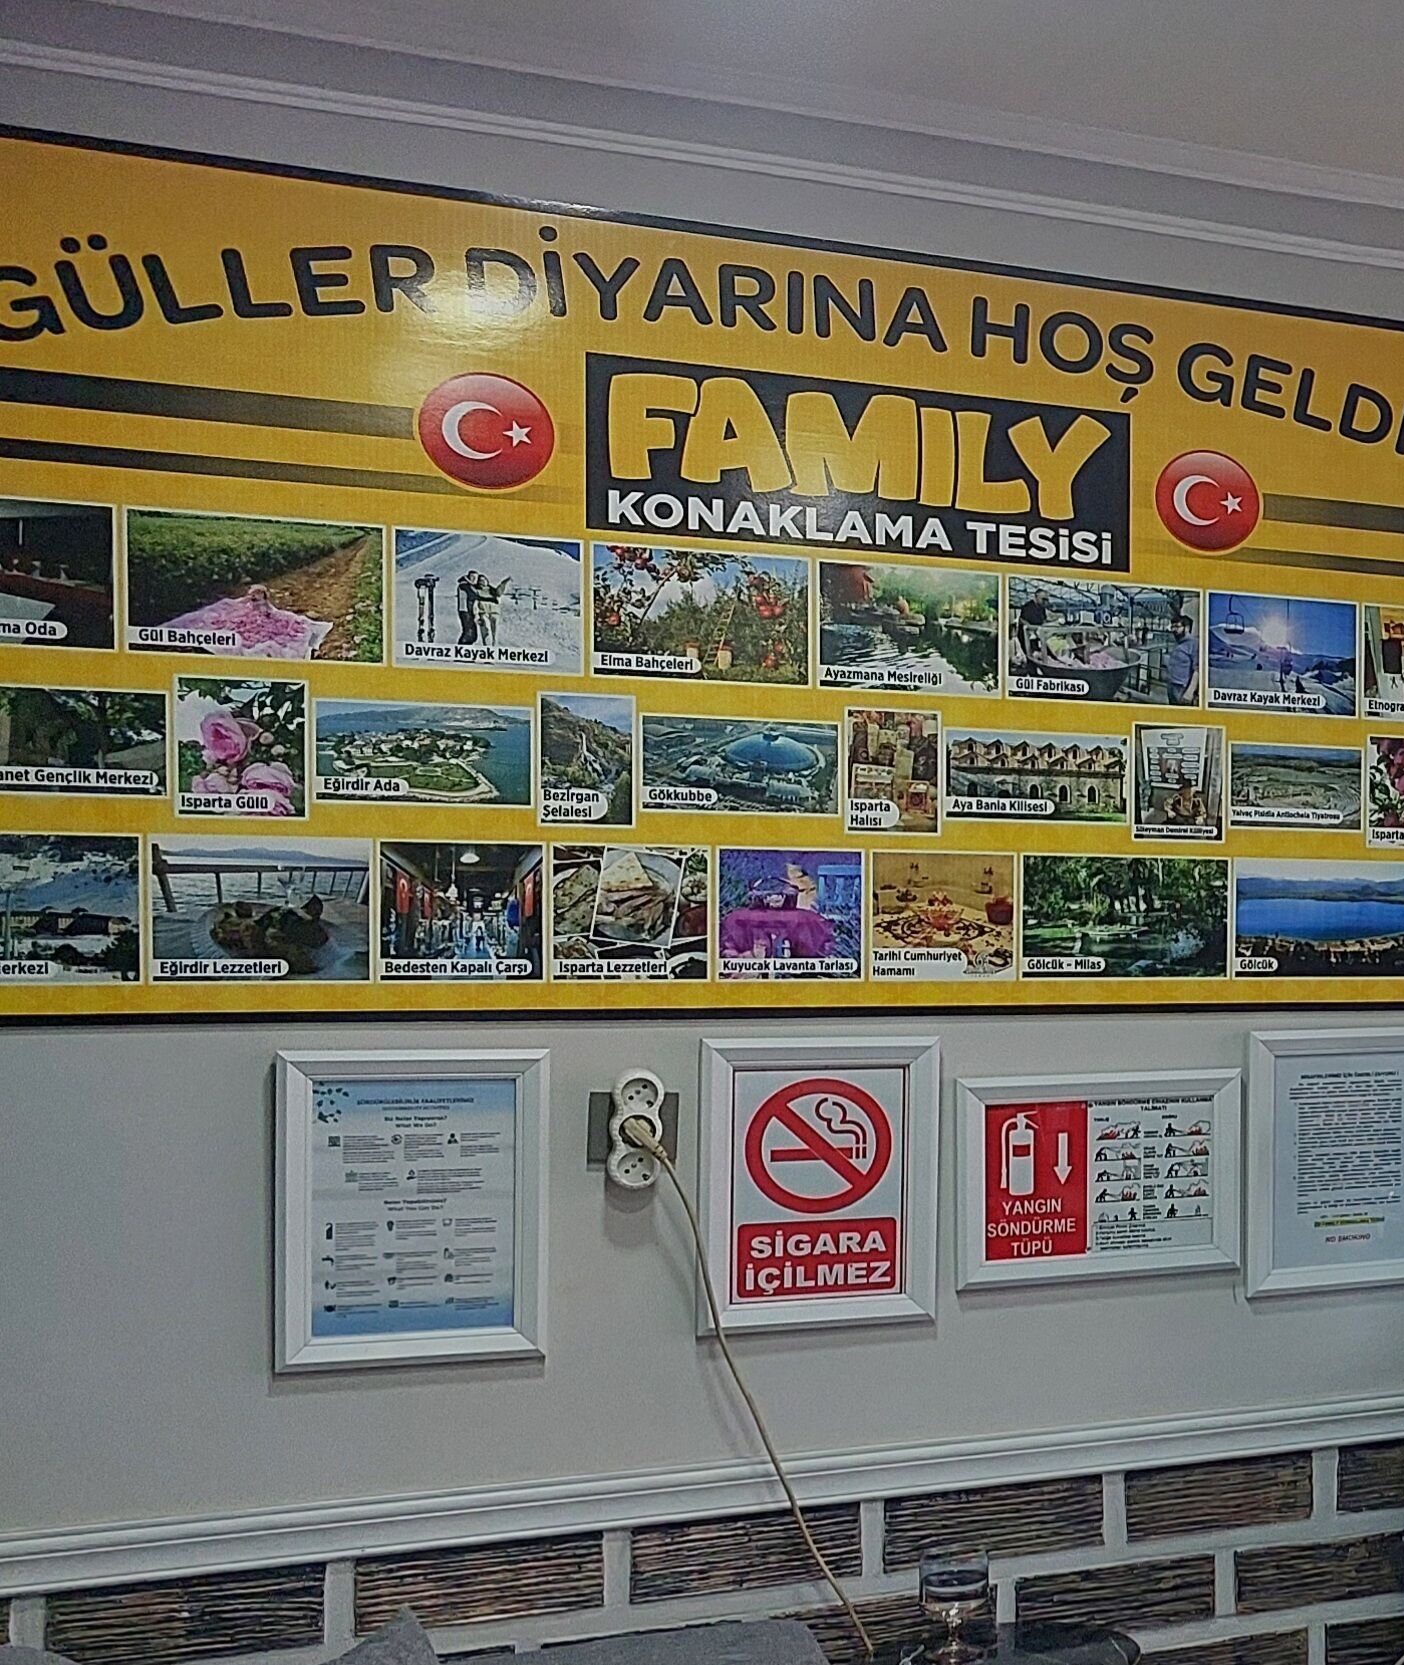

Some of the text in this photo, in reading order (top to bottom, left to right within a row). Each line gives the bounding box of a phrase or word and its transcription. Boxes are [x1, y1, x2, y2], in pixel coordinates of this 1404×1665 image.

[0, 234, 436, 342] GÜLLER
[464, 225, 947, 354] DİYARINA
[970, 296, 1156, 404] HOŞ
[606, 371, 1112, 521] FAMILY
[606, 490, 1113, 566] KONAKLAMA TESİSİ
[25, 621, 57, 636] Oda
[138, 628, 236, 648] Gül Bahçeleri
[405, 643, 549, 664] Davraz Kayak Merkezi
[600, 654, 694, 672] Elma Bahçeleri
[824, 666, 943, 686] Ayazmana Mesireliği
[1015, 677, 1086, 693] Gül Fabrikası
[1213, 691, 1321, 707] Davraz Kayak Merkezi
[35, 769, 91, 785] Gençlik
[95, 770, 154, 785] Merkezi
[323, 777, 400, 793] Eğirdir Ada
[181, 794, 269, 810] Isparta Gülü
[542, 788, 600, 805] Bezirgan
[648, 788, 713, 803] Gökkubbe
[542, 804, 593, 819] Şelalesi
[850, 800, 891, 815] Isparta
[952, 800, 973, 813] Aya
[1009, 801, 1048, 813] Kilisesi
[850, 814, 882, 827] Halısı
[1372, 829, 1403, 844] Isparta
[873, 949, 962, 965] Tarihi Cumhuriyet
[1026, 958, 1064, 972] Gölcük
[1239, 958, 1274, 971] Gölcük
[0, 961, 49, 975] erkezi
[159, 960, 282, 977] Eğirdir Lezzetleri
[384, 960, 528, 976] Bedesten Kapalı Çarşı
[558, 960, 667, 976] Isparta Lezzetleri
[722, 960, 854, 975] Kuyucak Lavanta Tarlası
[872, 964, 915, 976] Hamamı
[1002, 1198, 1062, 1216] YANGIN
[987, 1217, 1076, 1238] SÖNDÜRME
[750, 1230, 886, 1259] SİGARA
[1011, 1237, 1052, 1256] TÜPÜ
[745, 1261, 891, 1295] İÇİLMEZ
